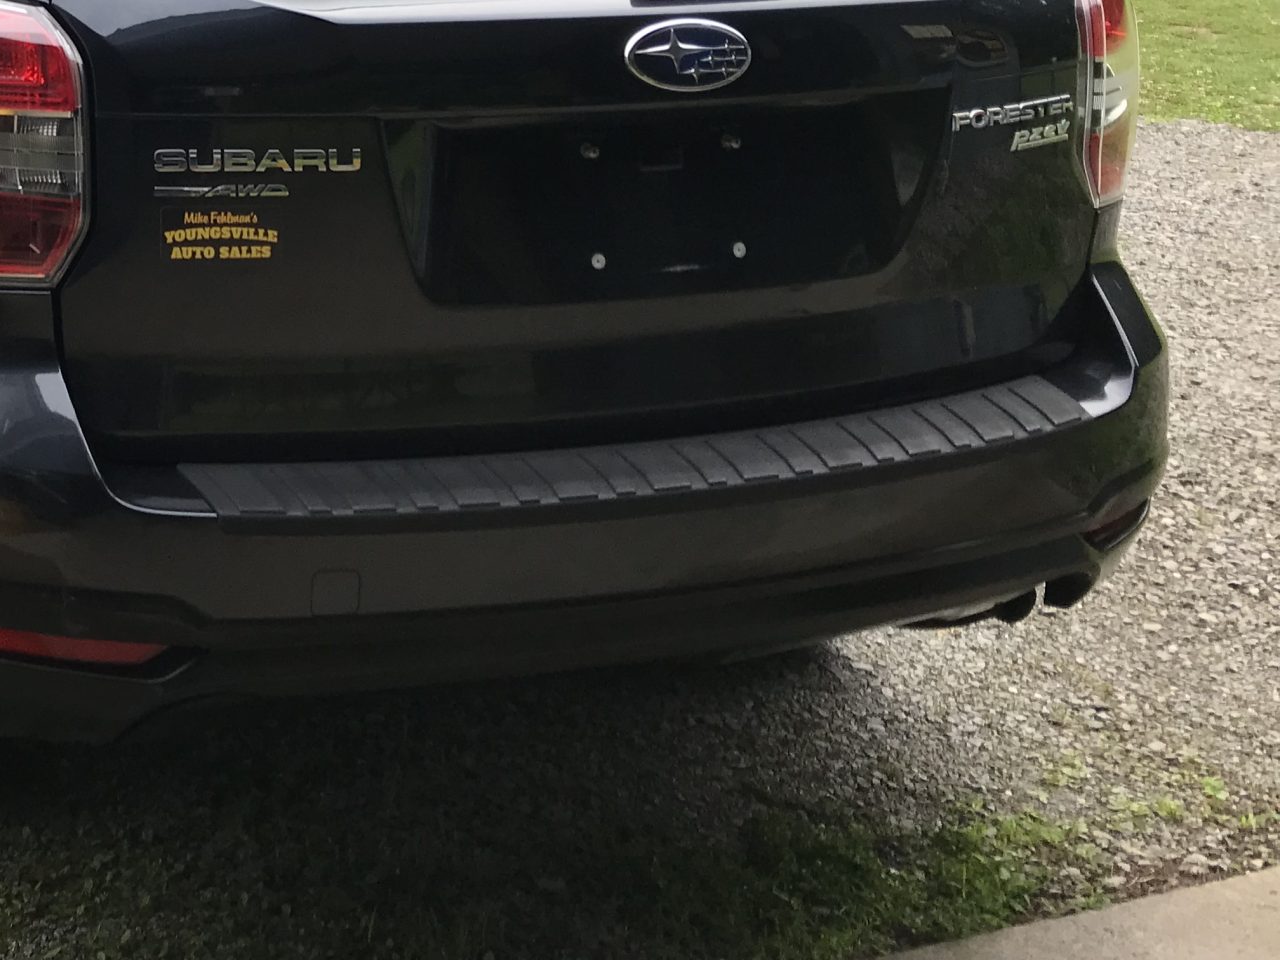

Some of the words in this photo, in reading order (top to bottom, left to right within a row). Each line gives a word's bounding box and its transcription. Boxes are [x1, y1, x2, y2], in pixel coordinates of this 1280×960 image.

[952, 94, 1073, 132] FORESTER
[153, 148, 361, 172] SUBARU
[205, 184, 289, 197] AWD
[183, 211, 208, 224] Mike
[164, 226, 278, 243] YOUNGSVILLE
[171, 246, 215, 259] AUTO
[219, 246, 272, 259] SALES
